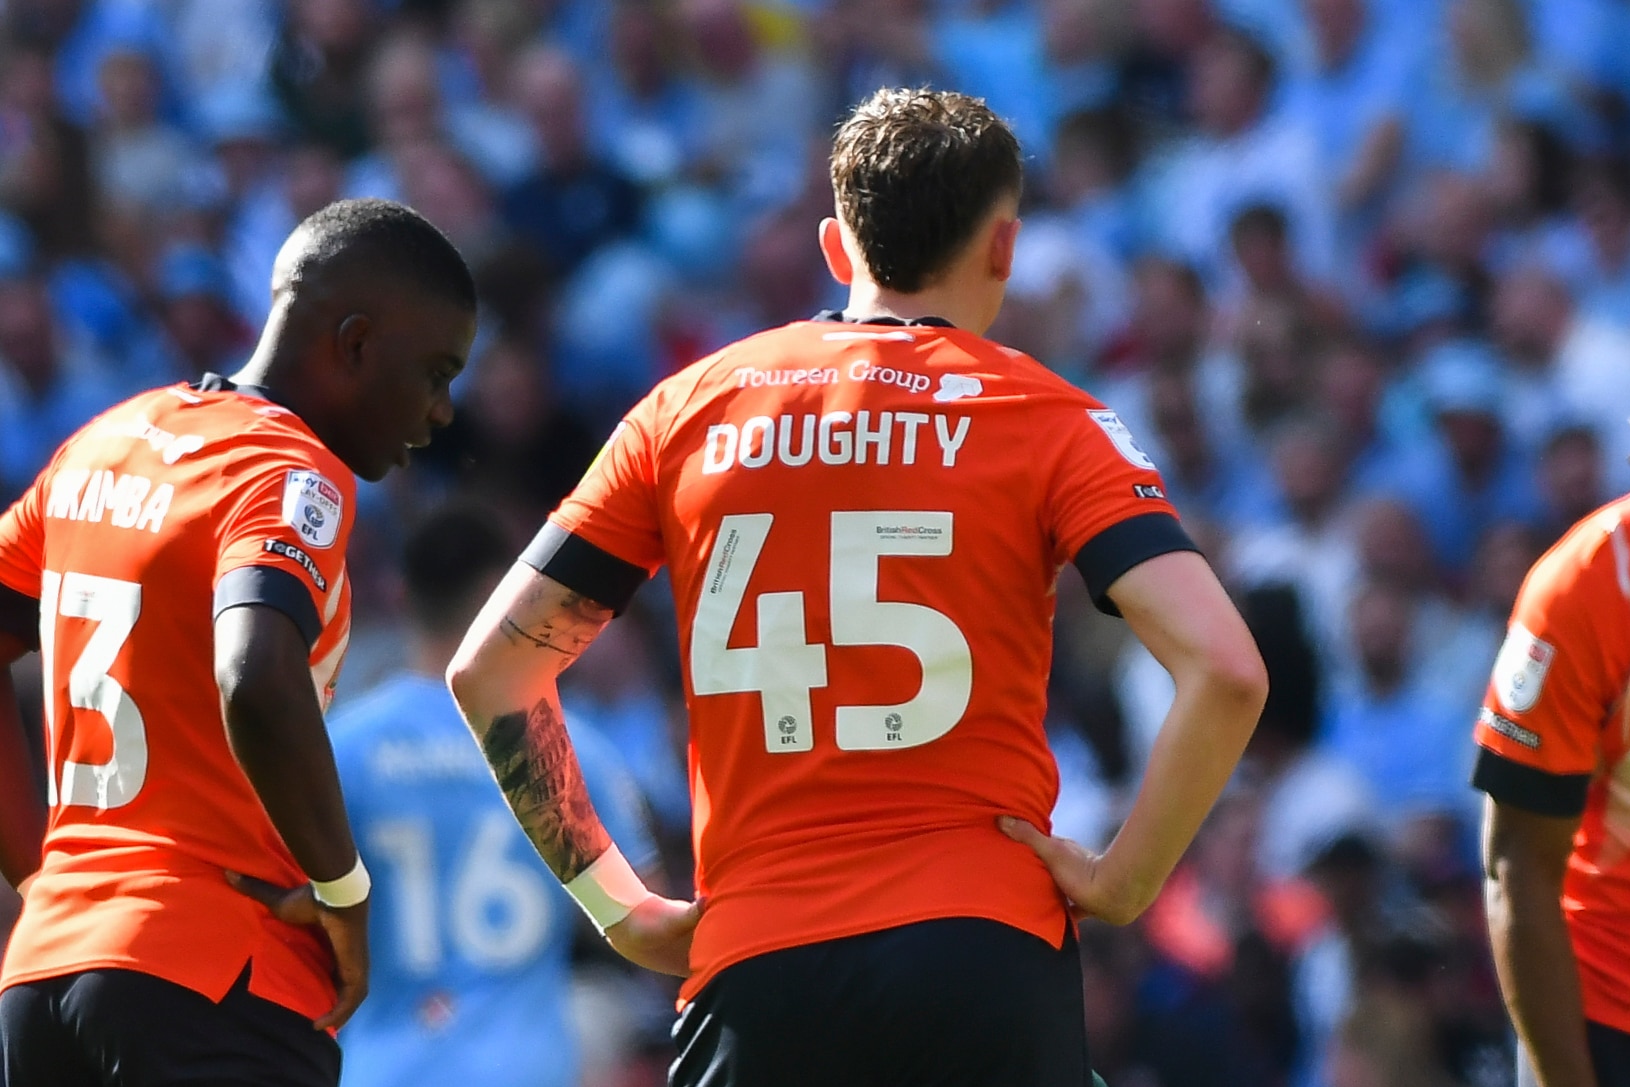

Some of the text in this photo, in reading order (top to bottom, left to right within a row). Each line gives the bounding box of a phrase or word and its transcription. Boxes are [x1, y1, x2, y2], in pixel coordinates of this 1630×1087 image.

[735, 360, 930, 392] Toureen Group
[702, 410, 971, 475] DOUGHTY
[302, 523, 319, 541] EFL
[690, 510, 973, 754] 45
[781, 736, 798, 744] EFL
[886, 733, 902, 741] EFL
[372, 814, 551, 975] 16
